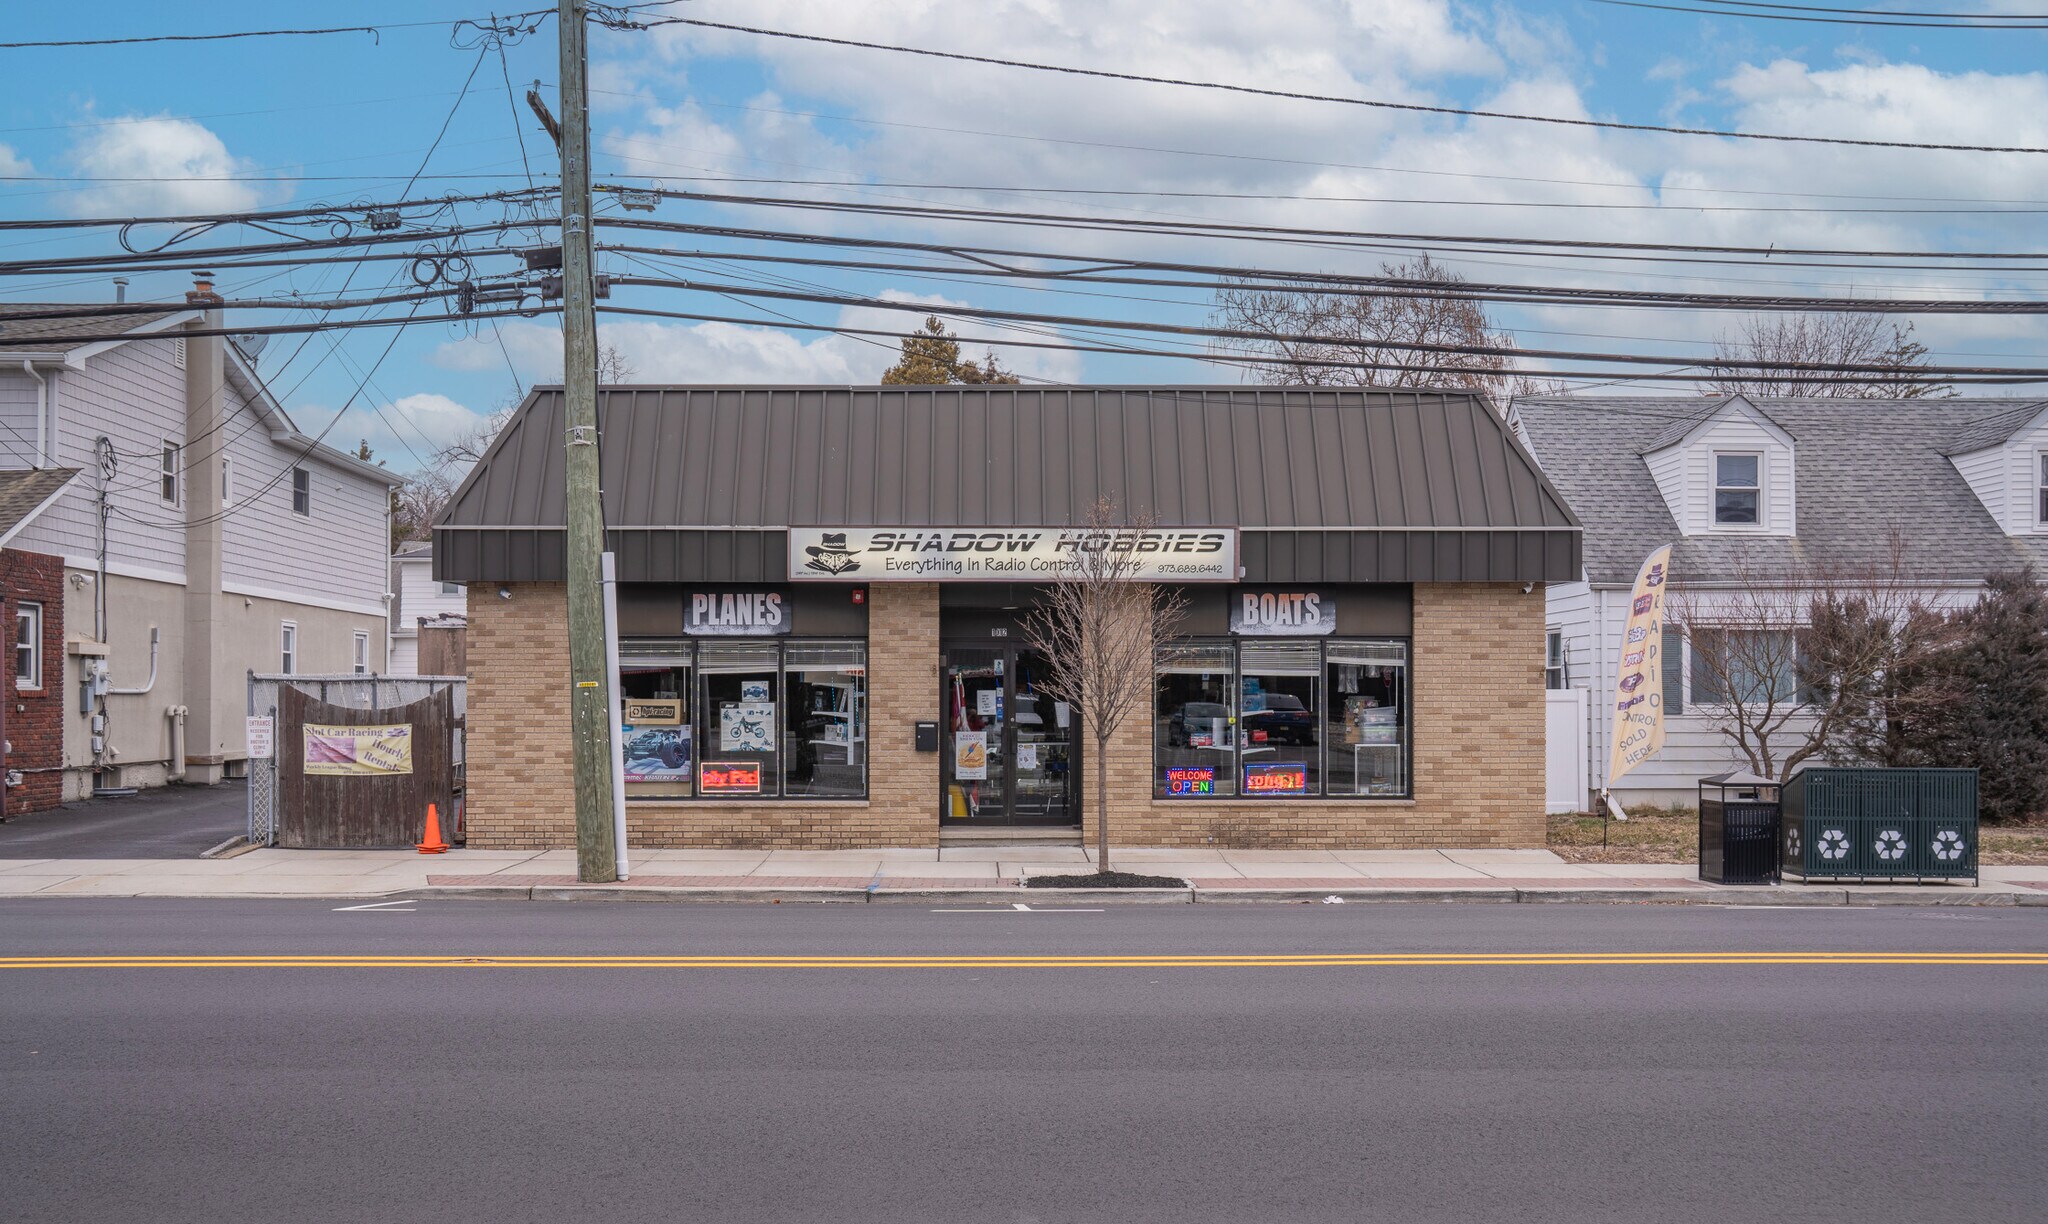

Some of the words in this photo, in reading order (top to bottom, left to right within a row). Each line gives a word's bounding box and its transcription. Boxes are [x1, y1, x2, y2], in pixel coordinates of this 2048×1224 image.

[867, 533, 1042, 552] SHADOW
[1054, 533, 1225, 553] HOBBIES
[885, 557, 962, 574] Everything
[967, 557, 980, 571] In
[985, 557, 1026, 571] Radio
[1104, 558, 1141, 571] More
[1158, 564, 1222, 574] 973.689.6442
[692, 592, 782, 626] PLANES
[1243, 592, 1320, 626] BOATS
[305, 727, 325, 736] Slot
[327, 728, 347, 736] Car
[348, 728, 384, 738] Racing
[1619, 728, 1647, 752] SOLD
[371, 738, 404, 761] Hourly
[1625, 743, 1653, 765] HERE
[363, 751, 400, 773] Rentals
[1170, 770, 1212, 781] WELCOME
[1172, 781, 1209, 792] OPEN
